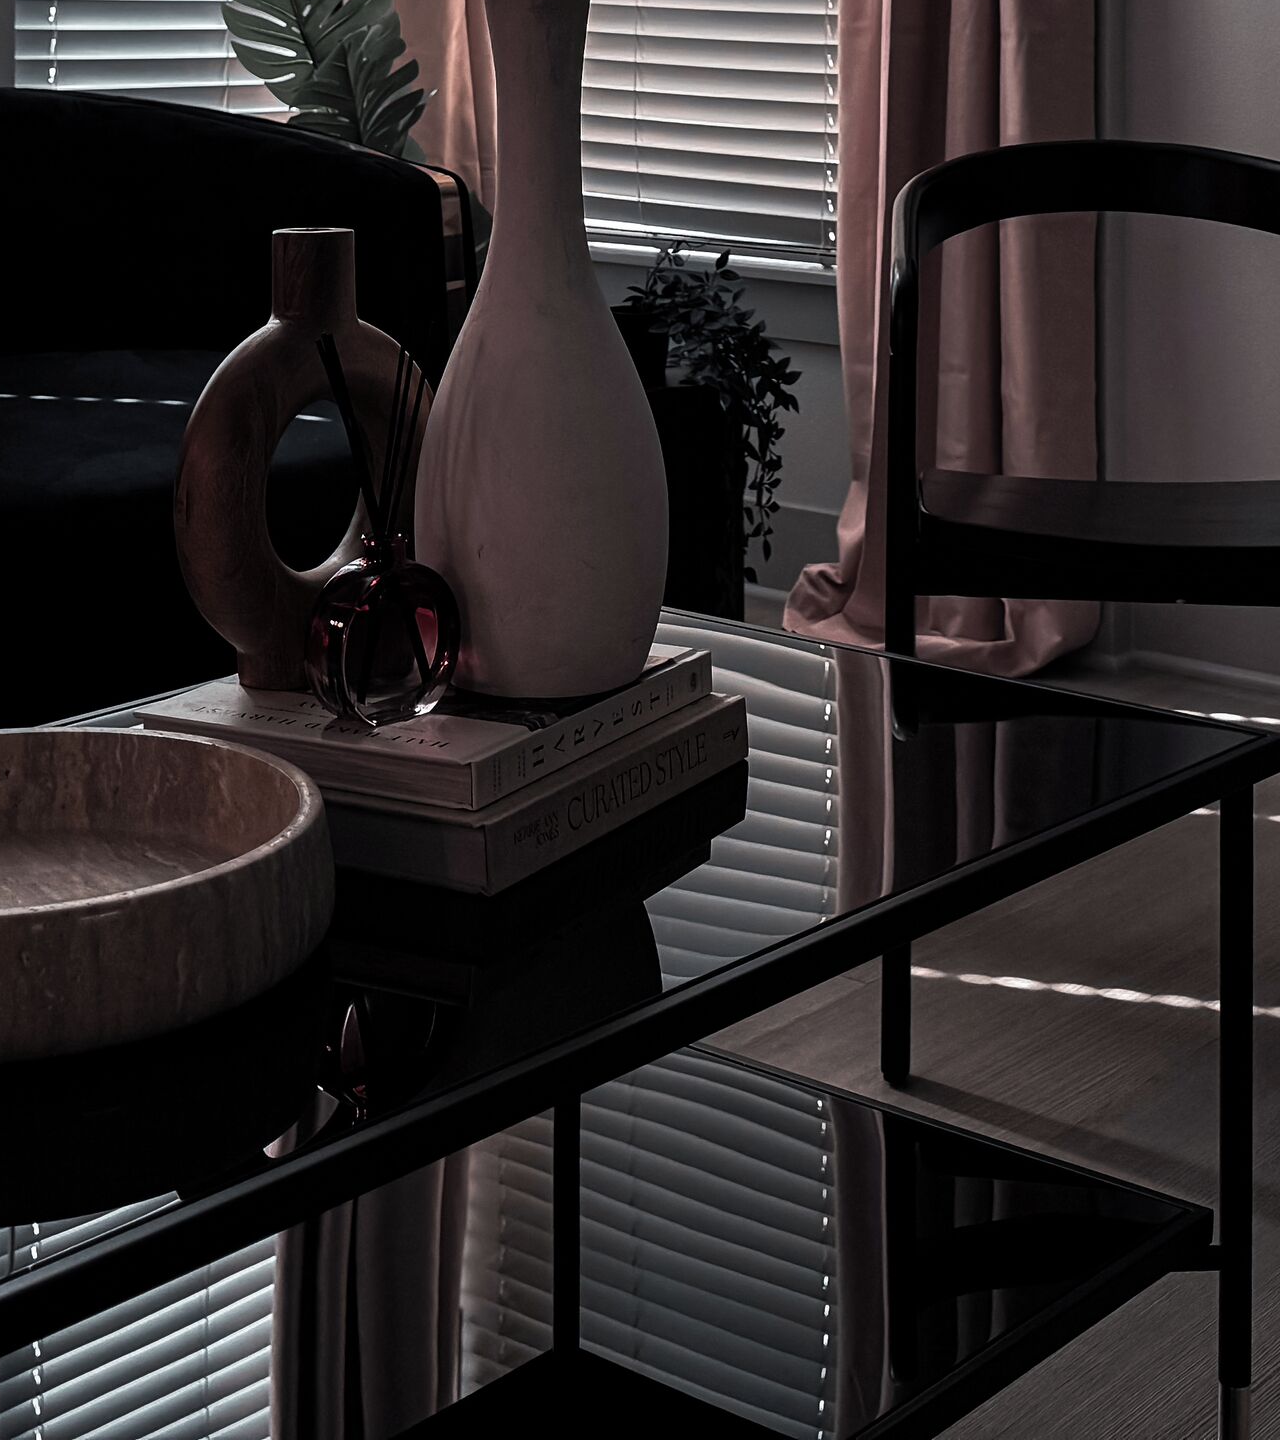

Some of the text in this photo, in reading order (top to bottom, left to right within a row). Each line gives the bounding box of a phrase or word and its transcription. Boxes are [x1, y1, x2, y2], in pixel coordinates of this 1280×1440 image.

[532, 691, 661, 768] HARVEST
[567, 760, 652, 831] CURATED
[655, 732, 708, 786] STYLE
